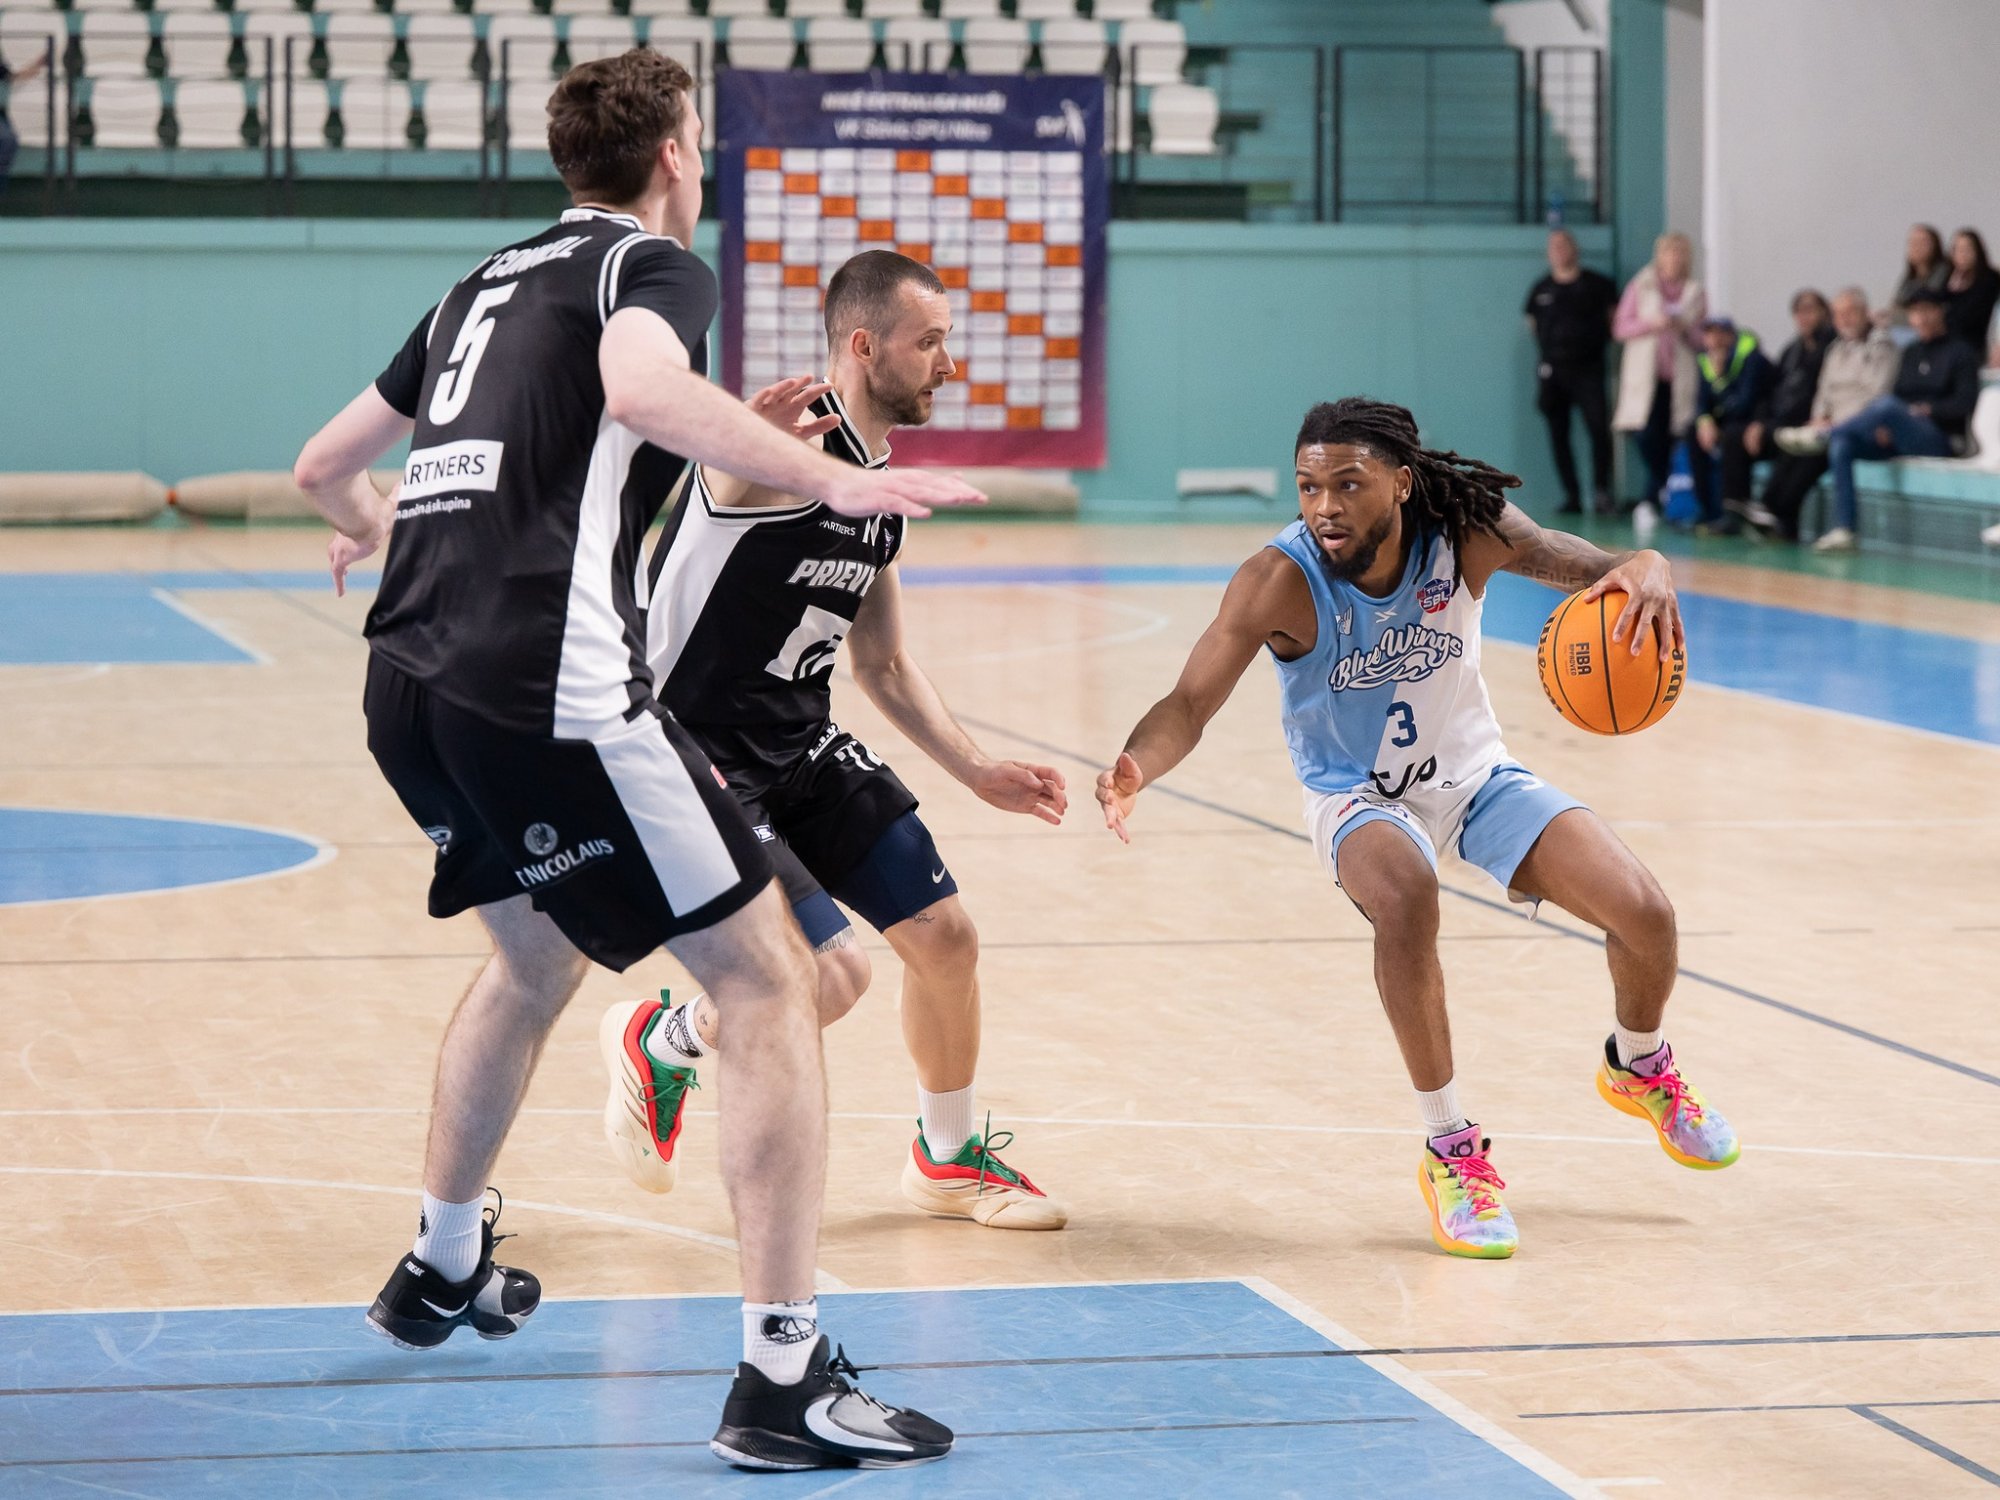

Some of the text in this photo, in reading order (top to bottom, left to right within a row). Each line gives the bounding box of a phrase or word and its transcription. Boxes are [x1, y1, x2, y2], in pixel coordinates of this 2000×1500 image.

[428, 281, 519, 426] 5
[404, 454, 486, 486] RTNERS
[1423, 591, 1450, 609] SBL
[1380, 623, 1464, 669] Wings
[1568, 643, 1577, 676] APPROVED
[1576, 642, 1592, 675] FIBA
[1386, 700, 1418, 748] 3
[522, 839, 614, 885] NICOLAUS
